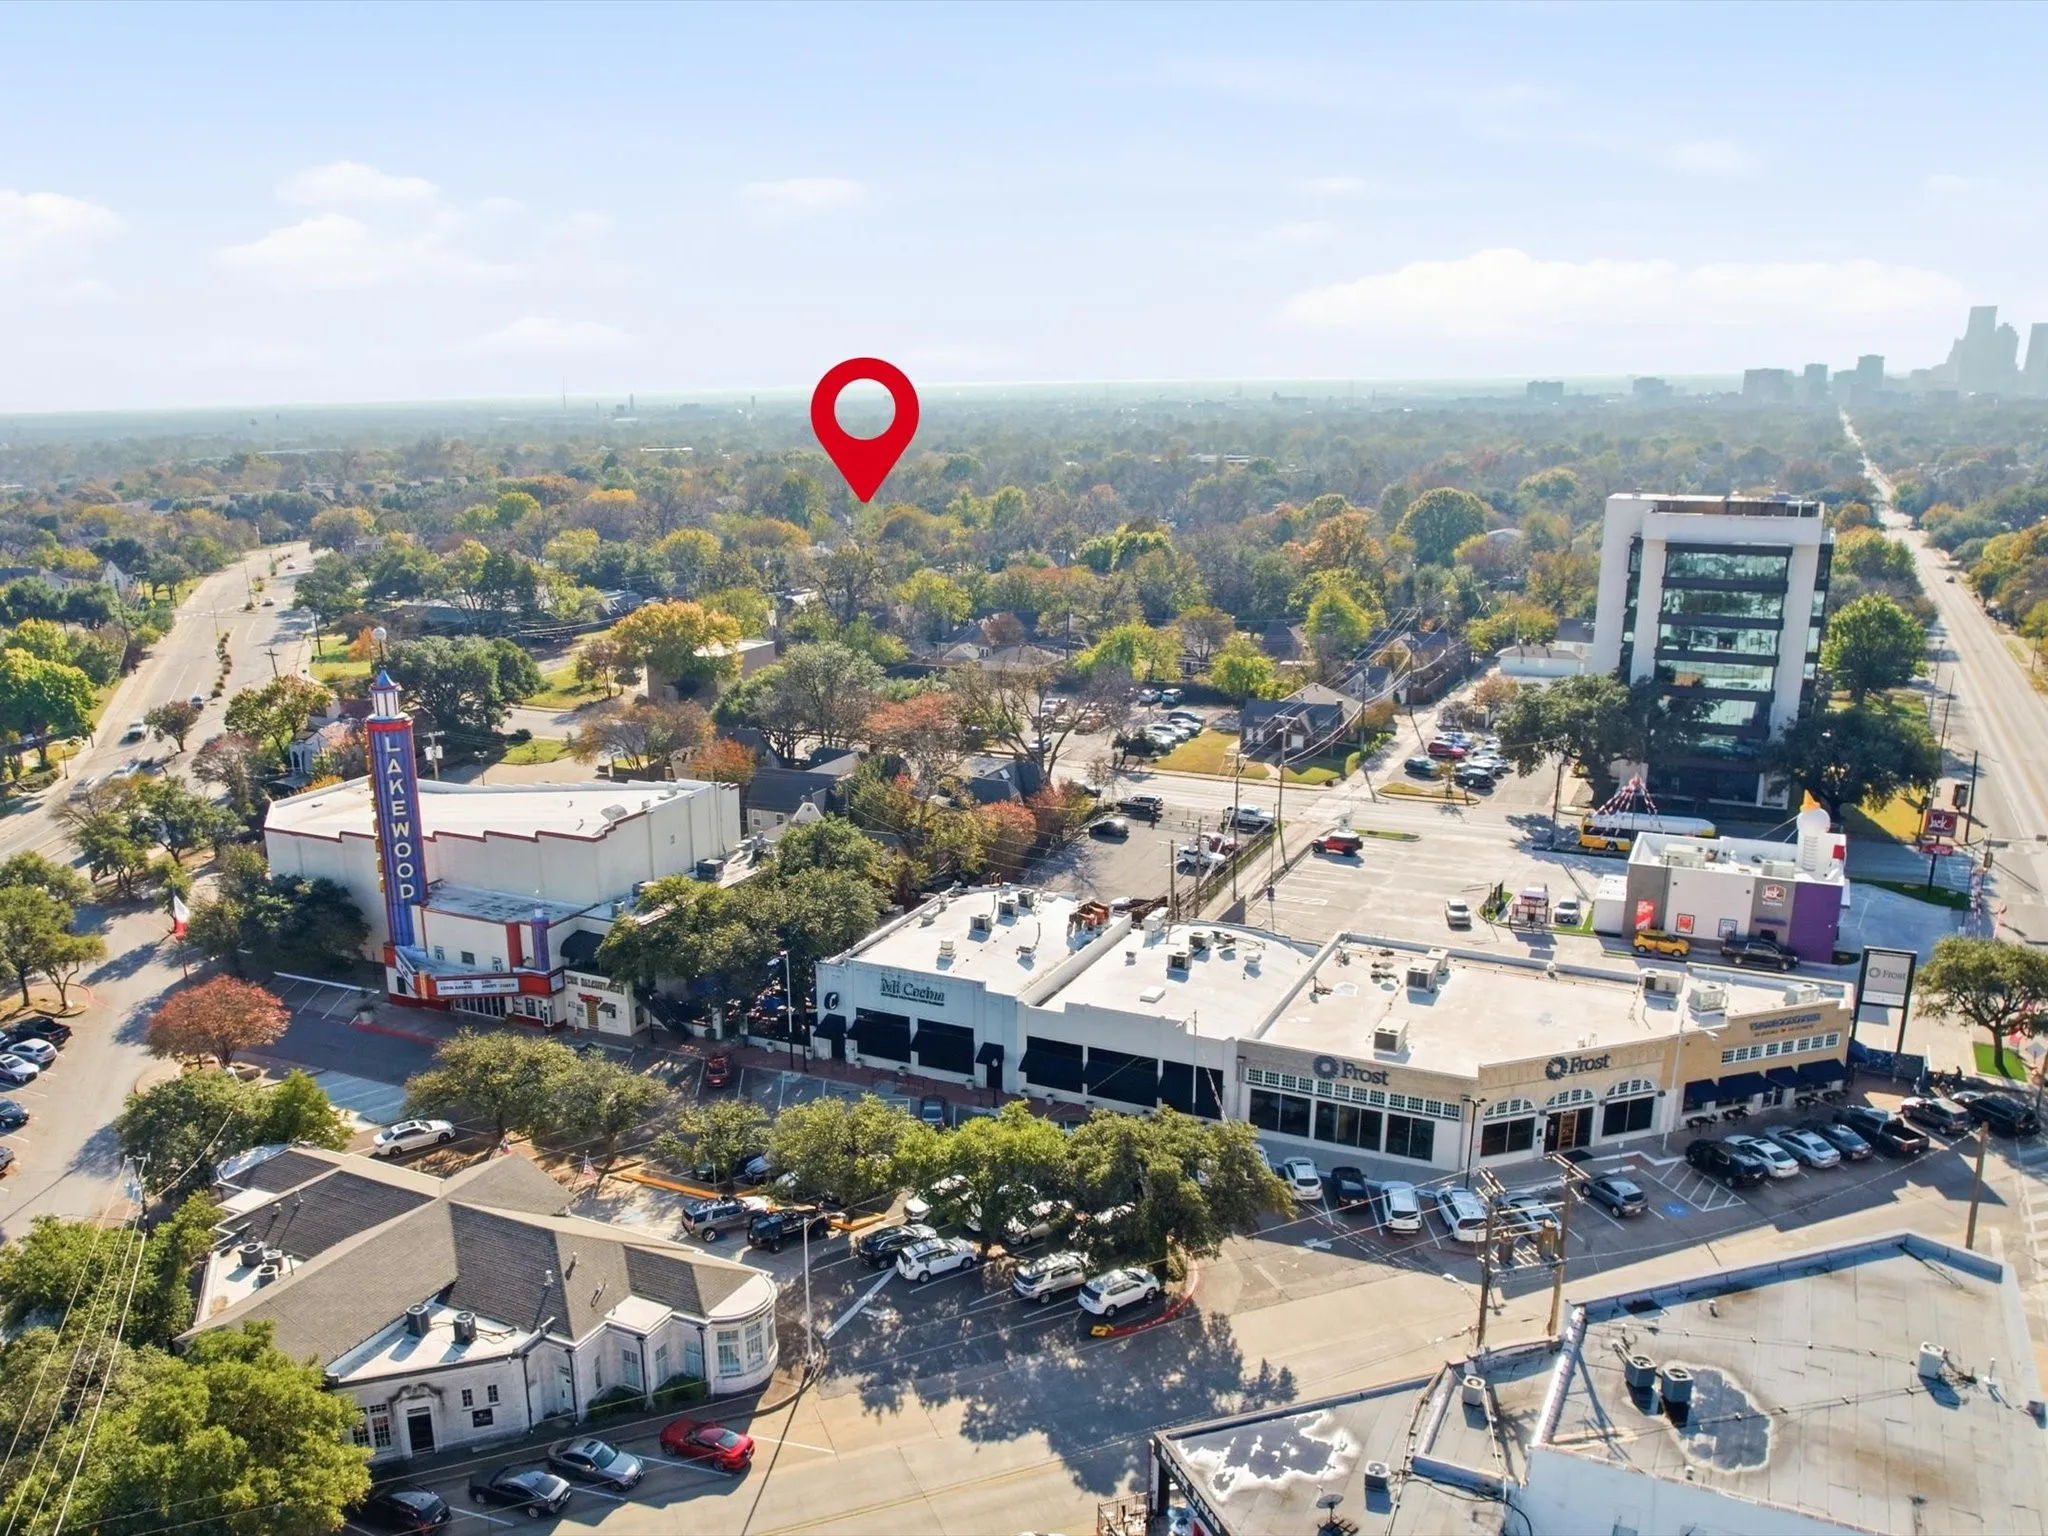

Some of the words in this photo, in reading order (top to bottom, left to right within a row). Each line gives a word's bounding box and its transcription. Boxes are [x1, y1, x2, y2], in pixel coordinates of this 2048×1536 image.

[385, 736, 415, 900] LAKEWOOD
[1882, 969, 1907, 981] Frost
[880, 977, 901, 993] Mi
[904, 982, 945, 1001] Cocina
[1341, 1060, 1390, 1086] Frost
[1569, 1054, 1611, 1074] Frost
